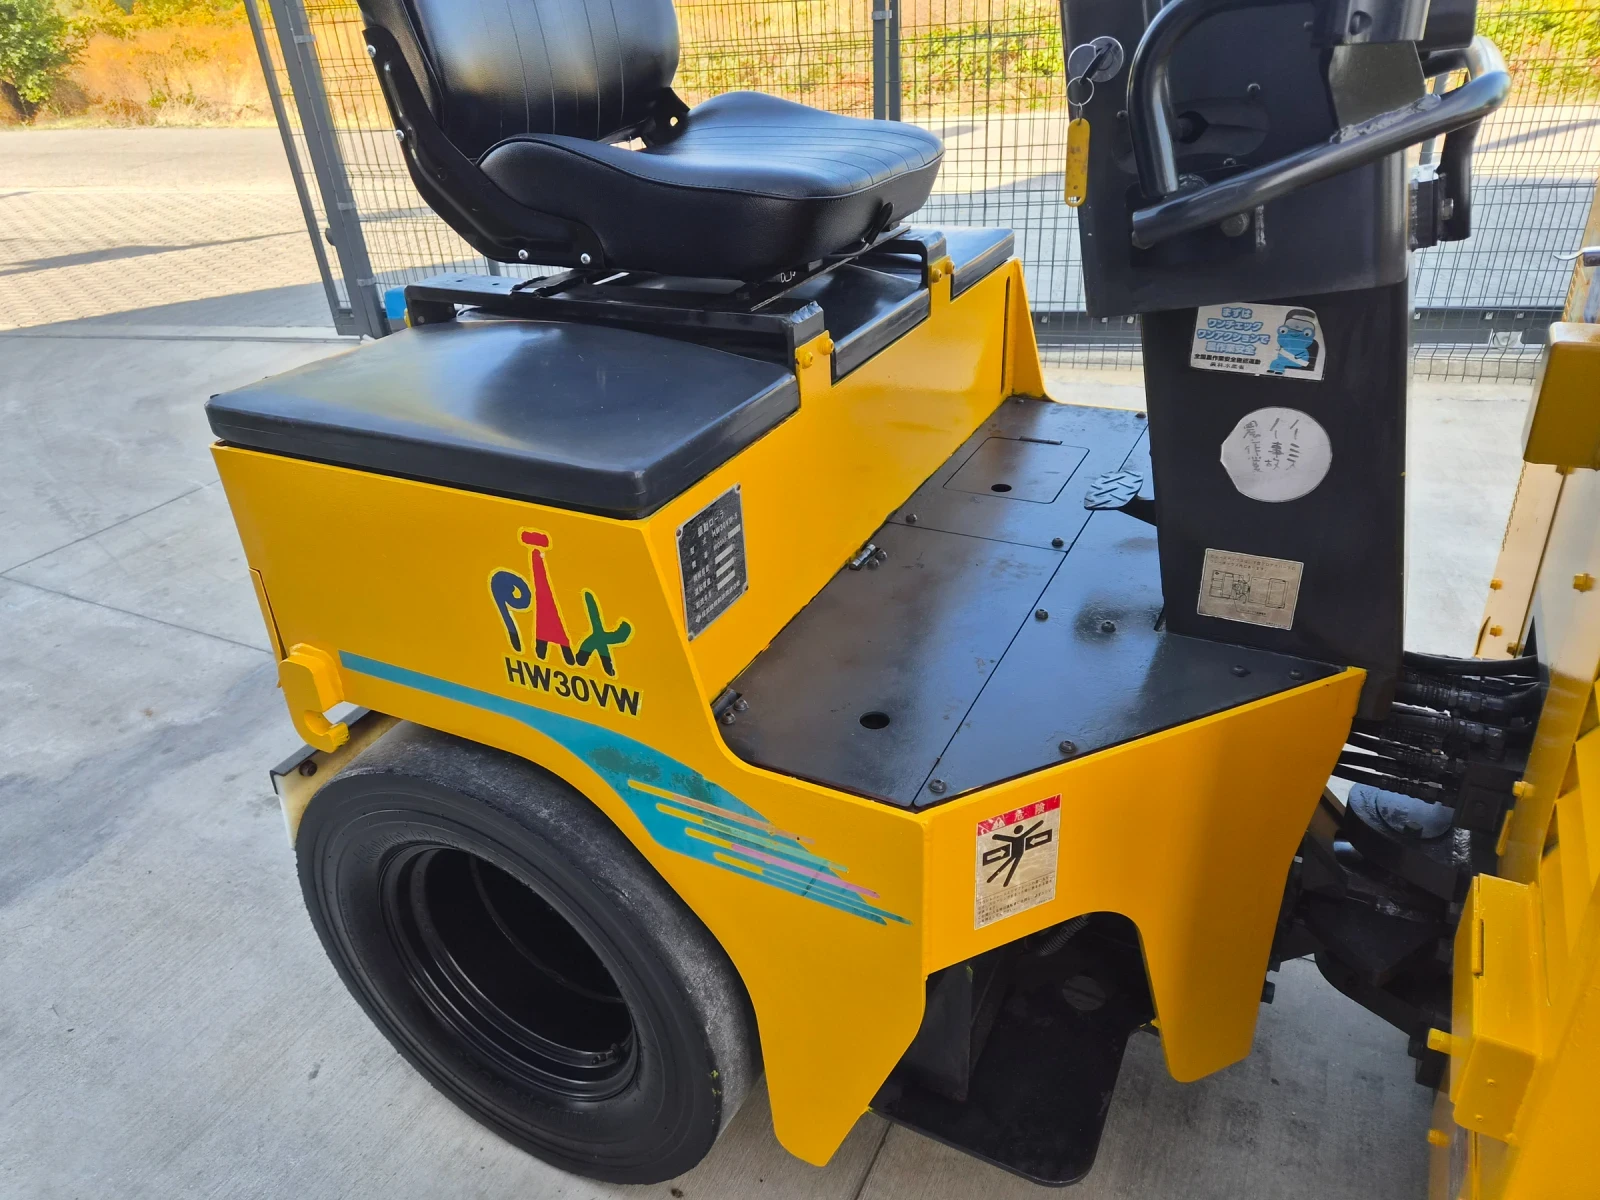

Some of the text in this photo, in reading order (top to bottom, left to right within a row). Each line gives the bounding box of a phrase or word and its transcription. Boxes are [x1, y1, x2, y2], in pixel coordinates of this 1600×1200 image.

[1221, 306, 1253, 319] まずは
[1207, 317, 1263, 332] ワンチェック
[1196, 329, 1271, 345] ワンアクションで
[1205, 341, 1256, 356] 農作業安全
[504, 656, 640, 716] HW30VW
[1014, 802, 1046, 822] 危険
